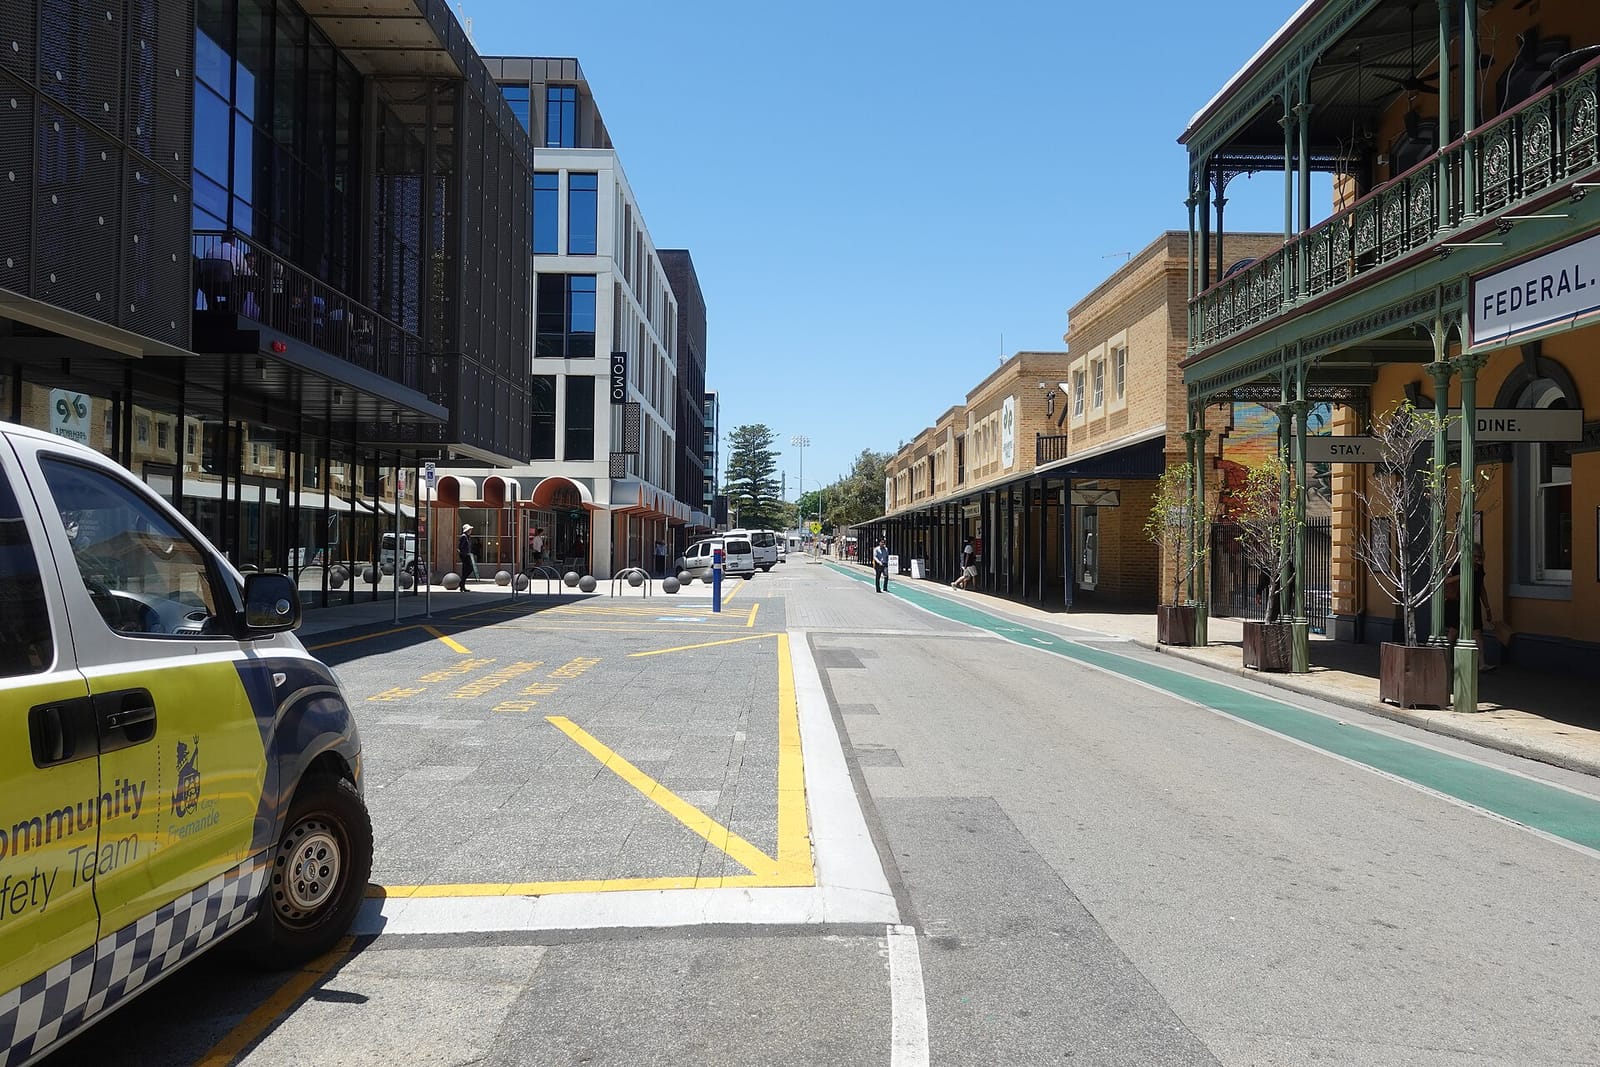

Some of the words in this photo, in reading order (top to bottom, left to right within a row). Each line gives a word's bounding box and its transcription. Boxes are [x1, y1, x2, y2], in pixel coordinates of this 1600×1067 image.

[1484, 265, 1595, 320] FEDERAL.
[613, 356, 624, 399] FOMO
[1477, 419, 1521, 432] DINE.
[1330, 445, 1365, 455] STAY.
[491, 700, 538, 712] DO
[518, 682, 566, 696] NOT
[167, 809, 220, 845] Fremantle
[68, 834, 138, 888] Team
